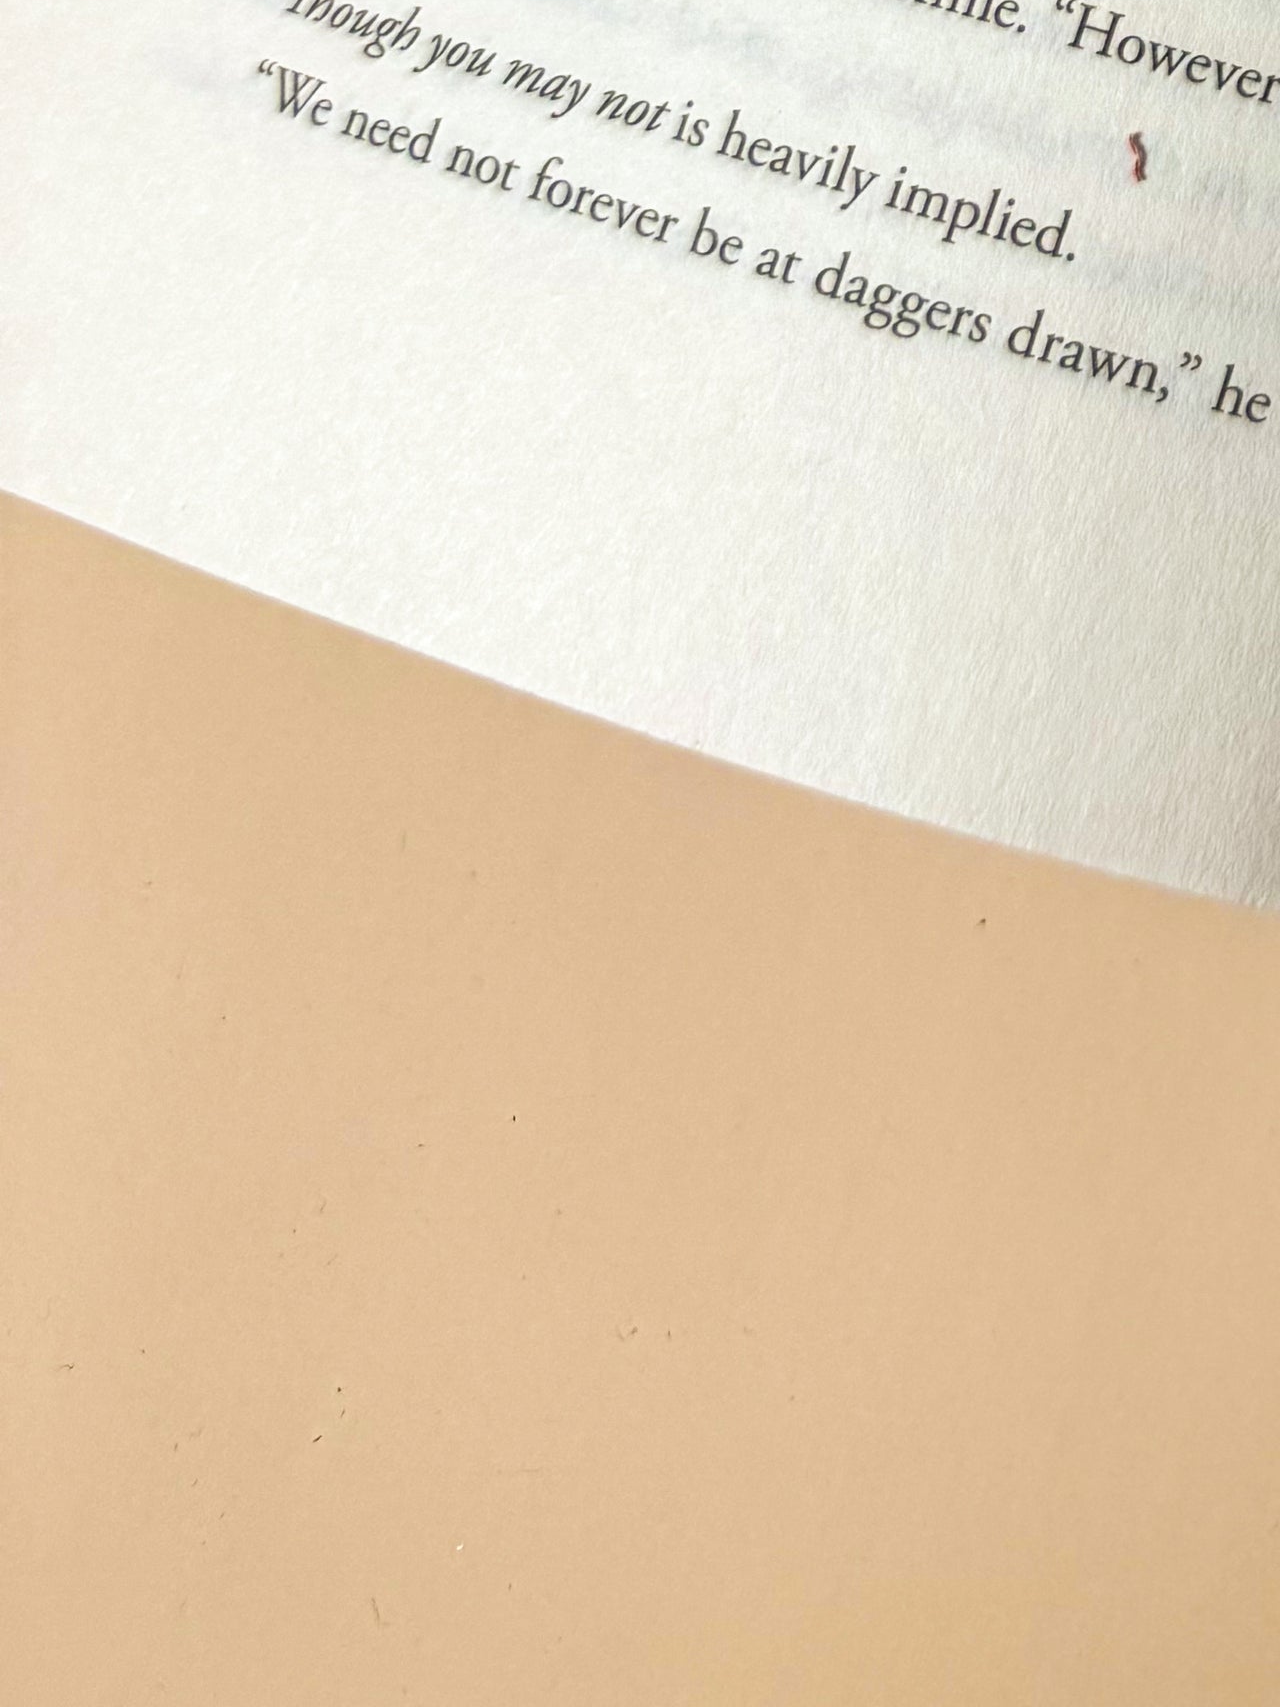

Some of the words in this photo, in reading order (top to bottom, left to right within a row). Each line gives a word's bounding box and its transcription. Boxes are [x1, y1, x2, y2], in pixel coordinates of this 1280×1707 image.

[257, 58, 333, 127] “We
[339, 109, 442, 164] need
[444, 145, 521, 192] not
[527, 156, 680, 244] forever
[688, 206, 744, 266] be
[754, 248, 803, 285] at
[814, 251, 992, 344] daggers
[1006, 308, 1203, 404] drawn,”
[1210, 363, 1272, 424] he
[411, 34, 497, 77] you
[501, 59, 592, 119] may
[595, 90, 672, 132] not
[671, 100, 710, 147] is
[715, 109, 881, 212] heavily
[884, 165, 1075, 262] implied.
